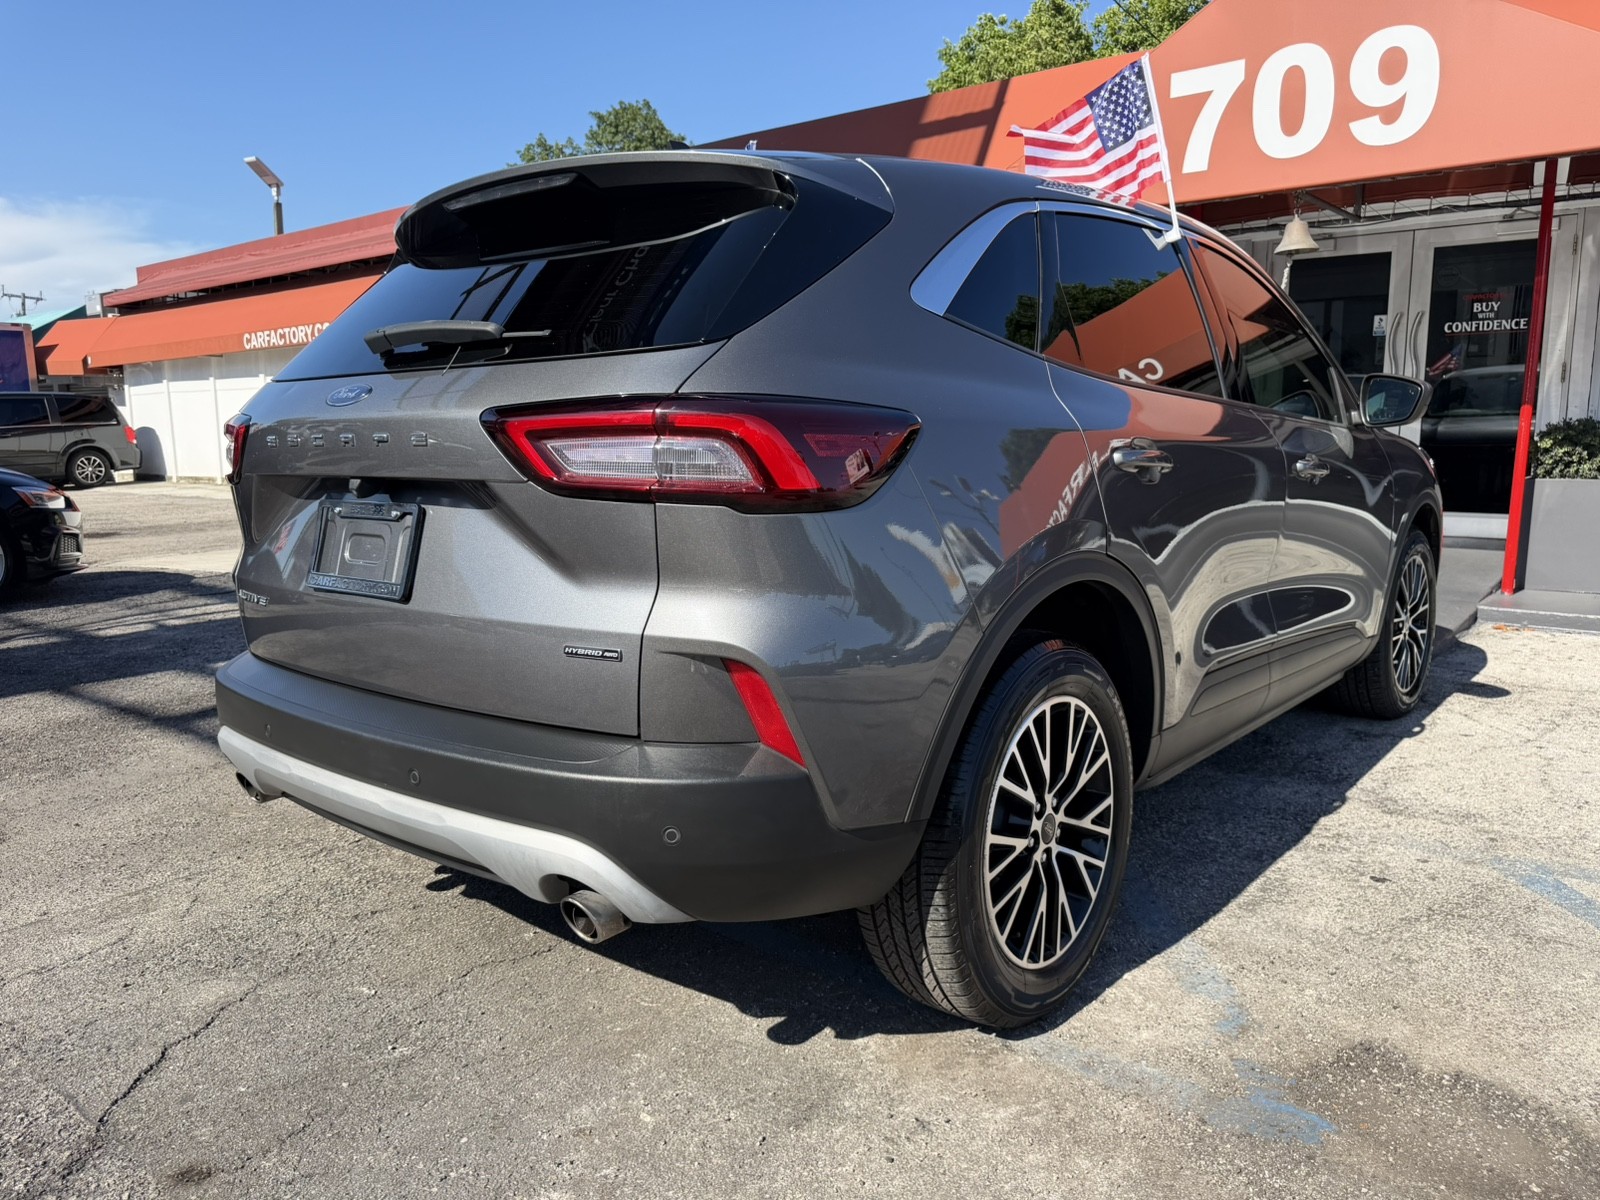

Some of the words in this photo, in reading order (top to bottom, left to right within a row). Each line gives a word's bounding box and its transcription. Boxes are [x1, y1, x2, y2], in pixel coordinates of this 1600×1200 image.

[1169, 24, 1440, 175] 709
[1473, 301, 1501, 313] BUY
[1444, 318, 1529, 333] CONFIDENCE
[564, 647, 603, 657] HYBRID
